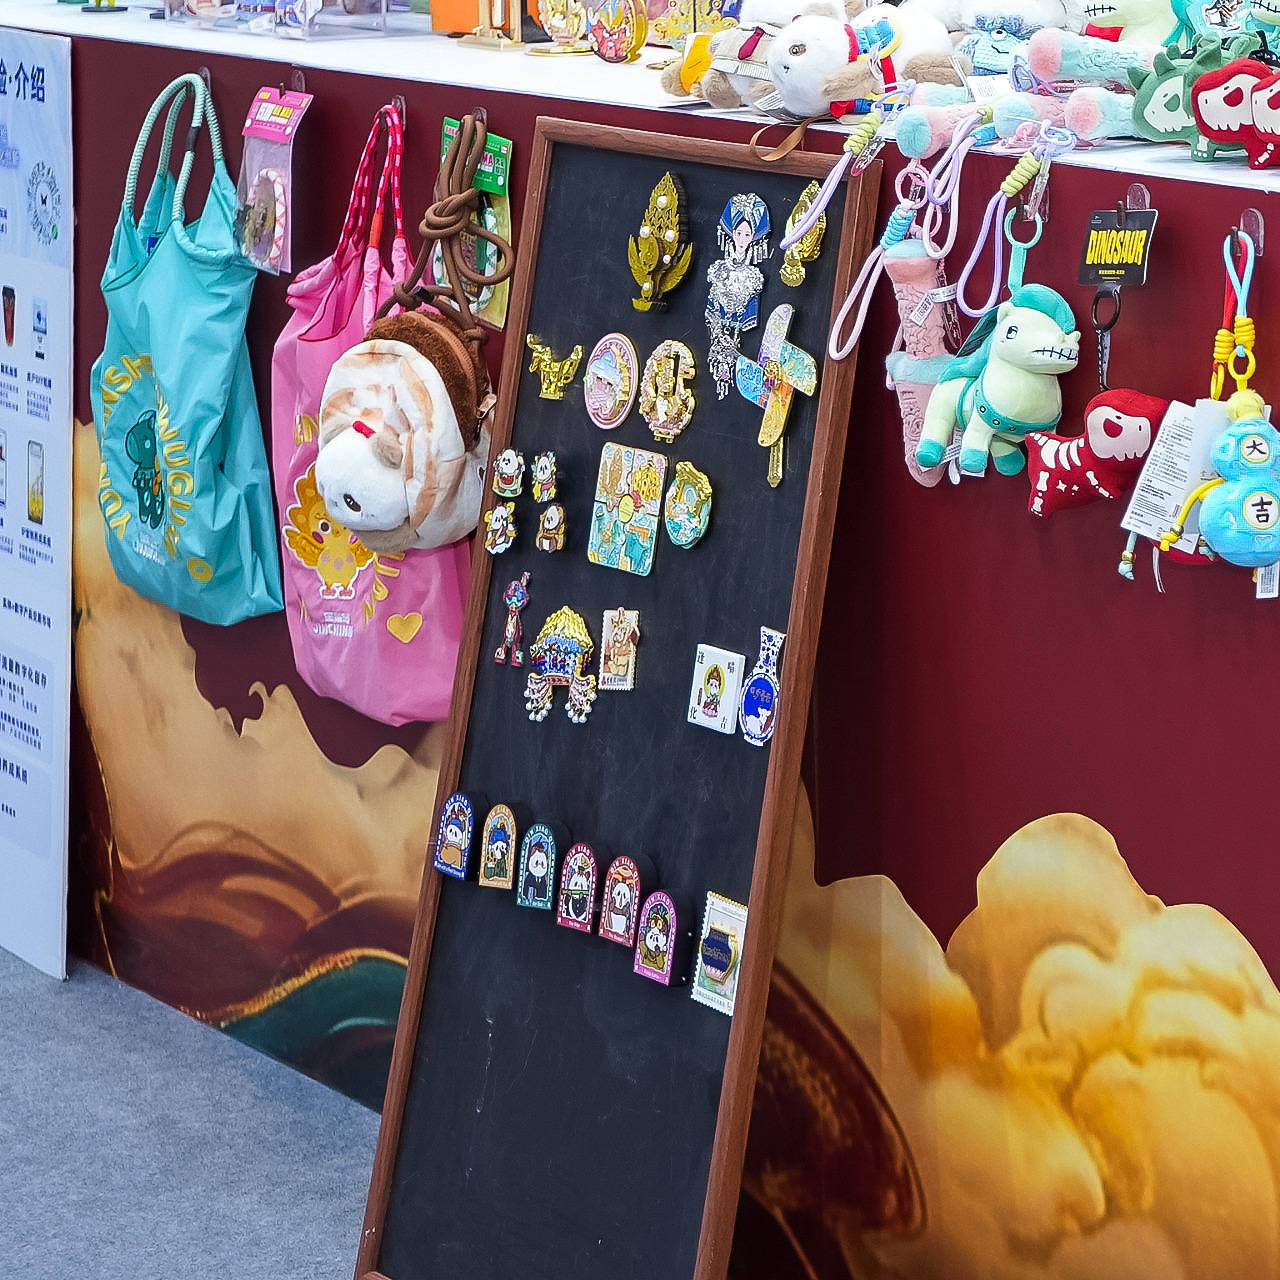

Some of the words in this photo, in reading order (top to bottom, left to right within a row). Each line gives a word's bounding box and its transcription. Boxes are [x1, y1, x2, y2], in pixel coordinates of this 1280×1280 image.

[1085, 228, 1148, 266] DINOSAUR
[1245, 438, 1264, 458] 大
[1251, 495, 1274, 523] 吉
